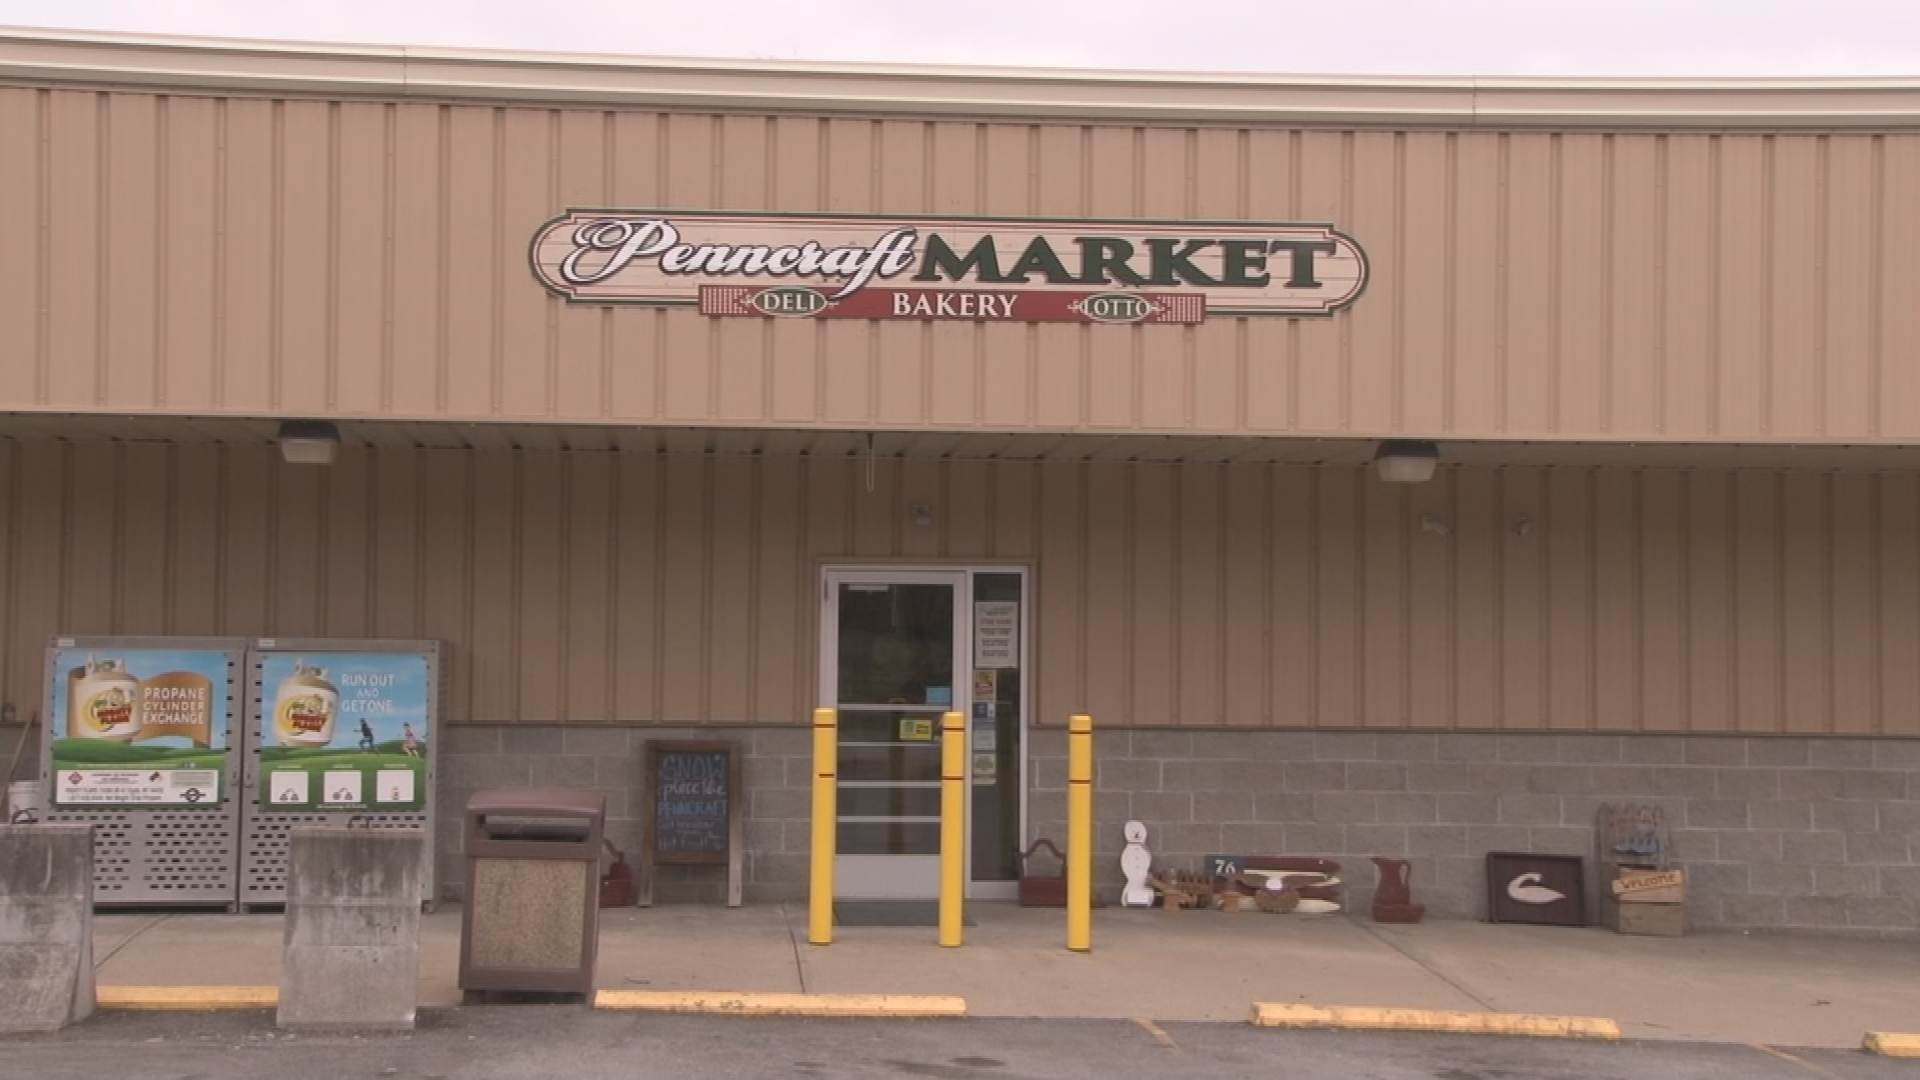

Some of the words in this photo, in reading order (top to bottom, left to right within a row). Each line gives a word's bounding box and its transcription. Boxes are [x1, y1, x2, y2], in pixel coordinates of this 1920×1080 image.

[561, 217, 918, 301] Penncraft
[911, 233, 1337, 289] MARKET
[761, 292, 817, 312] DELI
[892, 292, 1019, 317] BAKERY
[1083, 298, 1149, 319] LOTTO
[340, 674, 367, 686] RUN
[369, 674, 396, 686] OUT
[144, 687, 205, 699] PROPANE
[357, 688, 380, 699] AND
[143, 701, 205, 711] CYLINDER
[341, 700, 365, 713] GET
[367, 700, 394, 713] ONE
[142, 712, 204, 724] EXCHANGE
